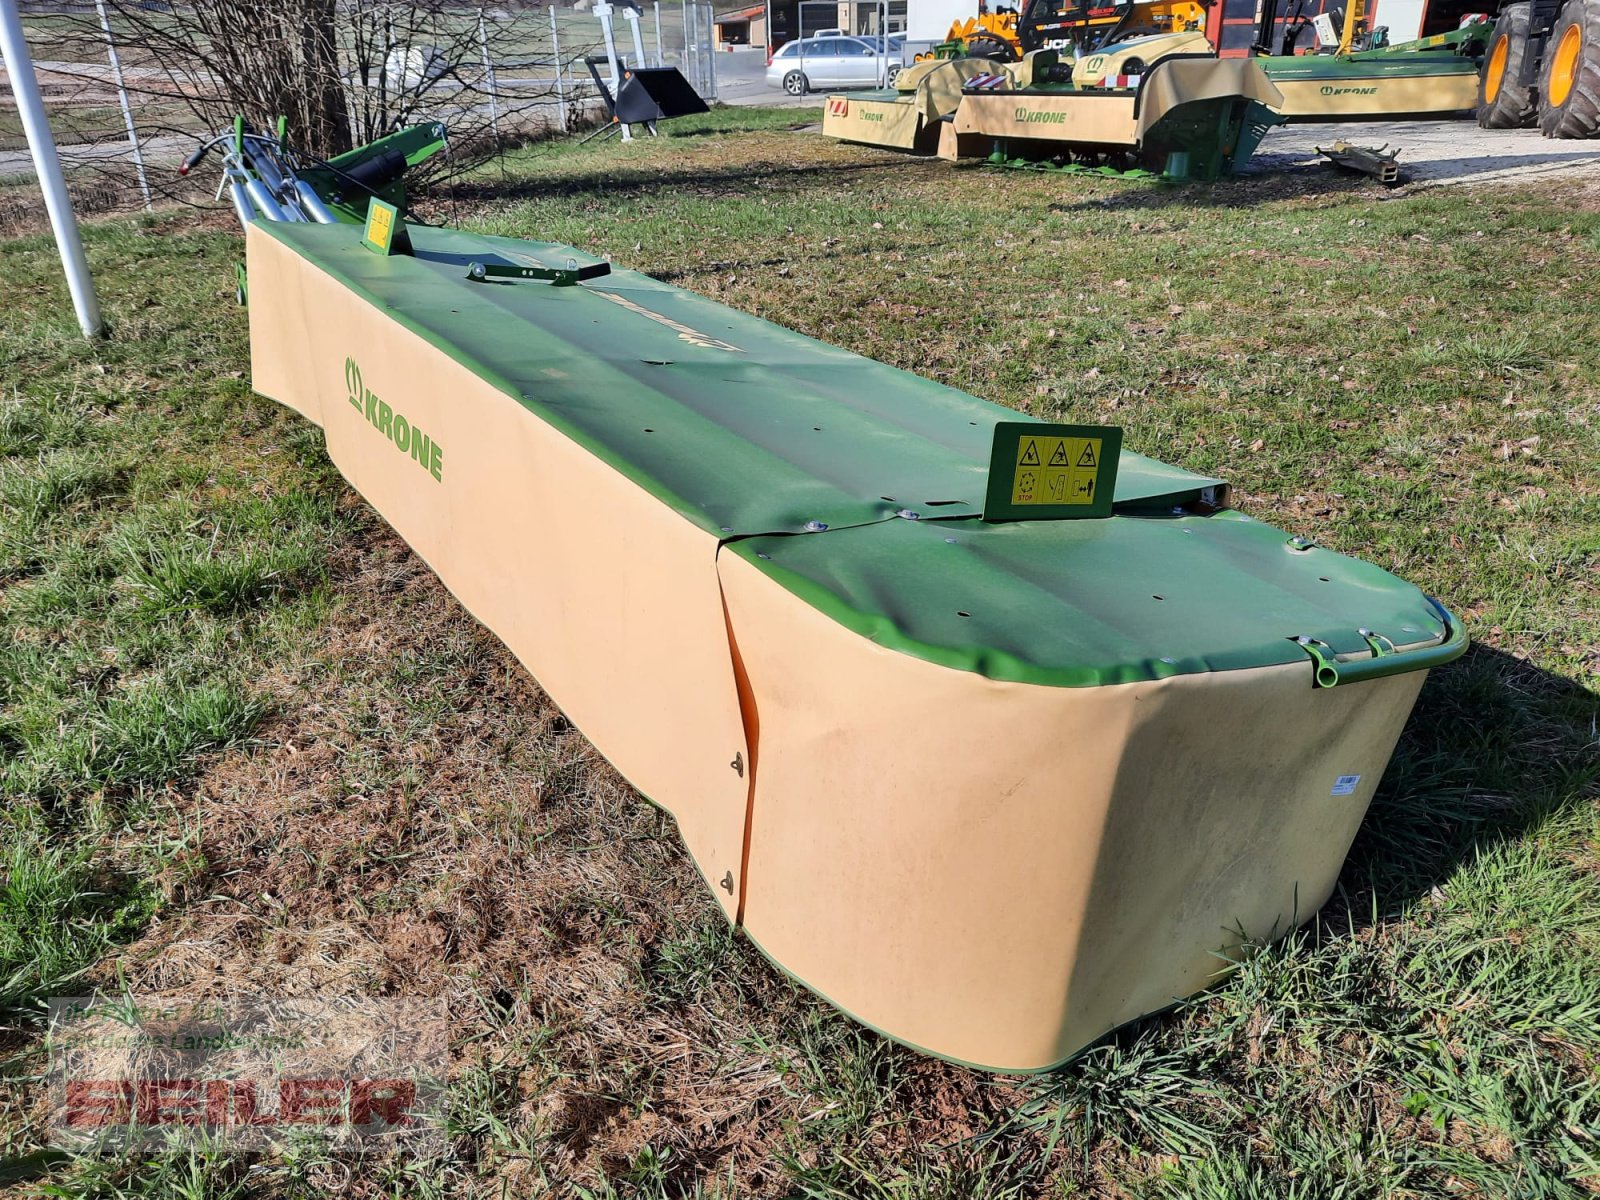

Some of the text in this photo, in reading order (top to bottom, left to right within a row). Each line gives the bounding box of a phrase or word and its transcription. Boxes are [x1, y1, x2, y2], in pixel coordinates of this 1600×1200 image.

[1333, 87, 1378, 96] KRONE
[864, 112, 884, 123] KRONE
[1026, 111, 1068, 125] KRONE
[365, 388, 443, 483] KRONE
[1017, 494, 1033, 502] STOP
